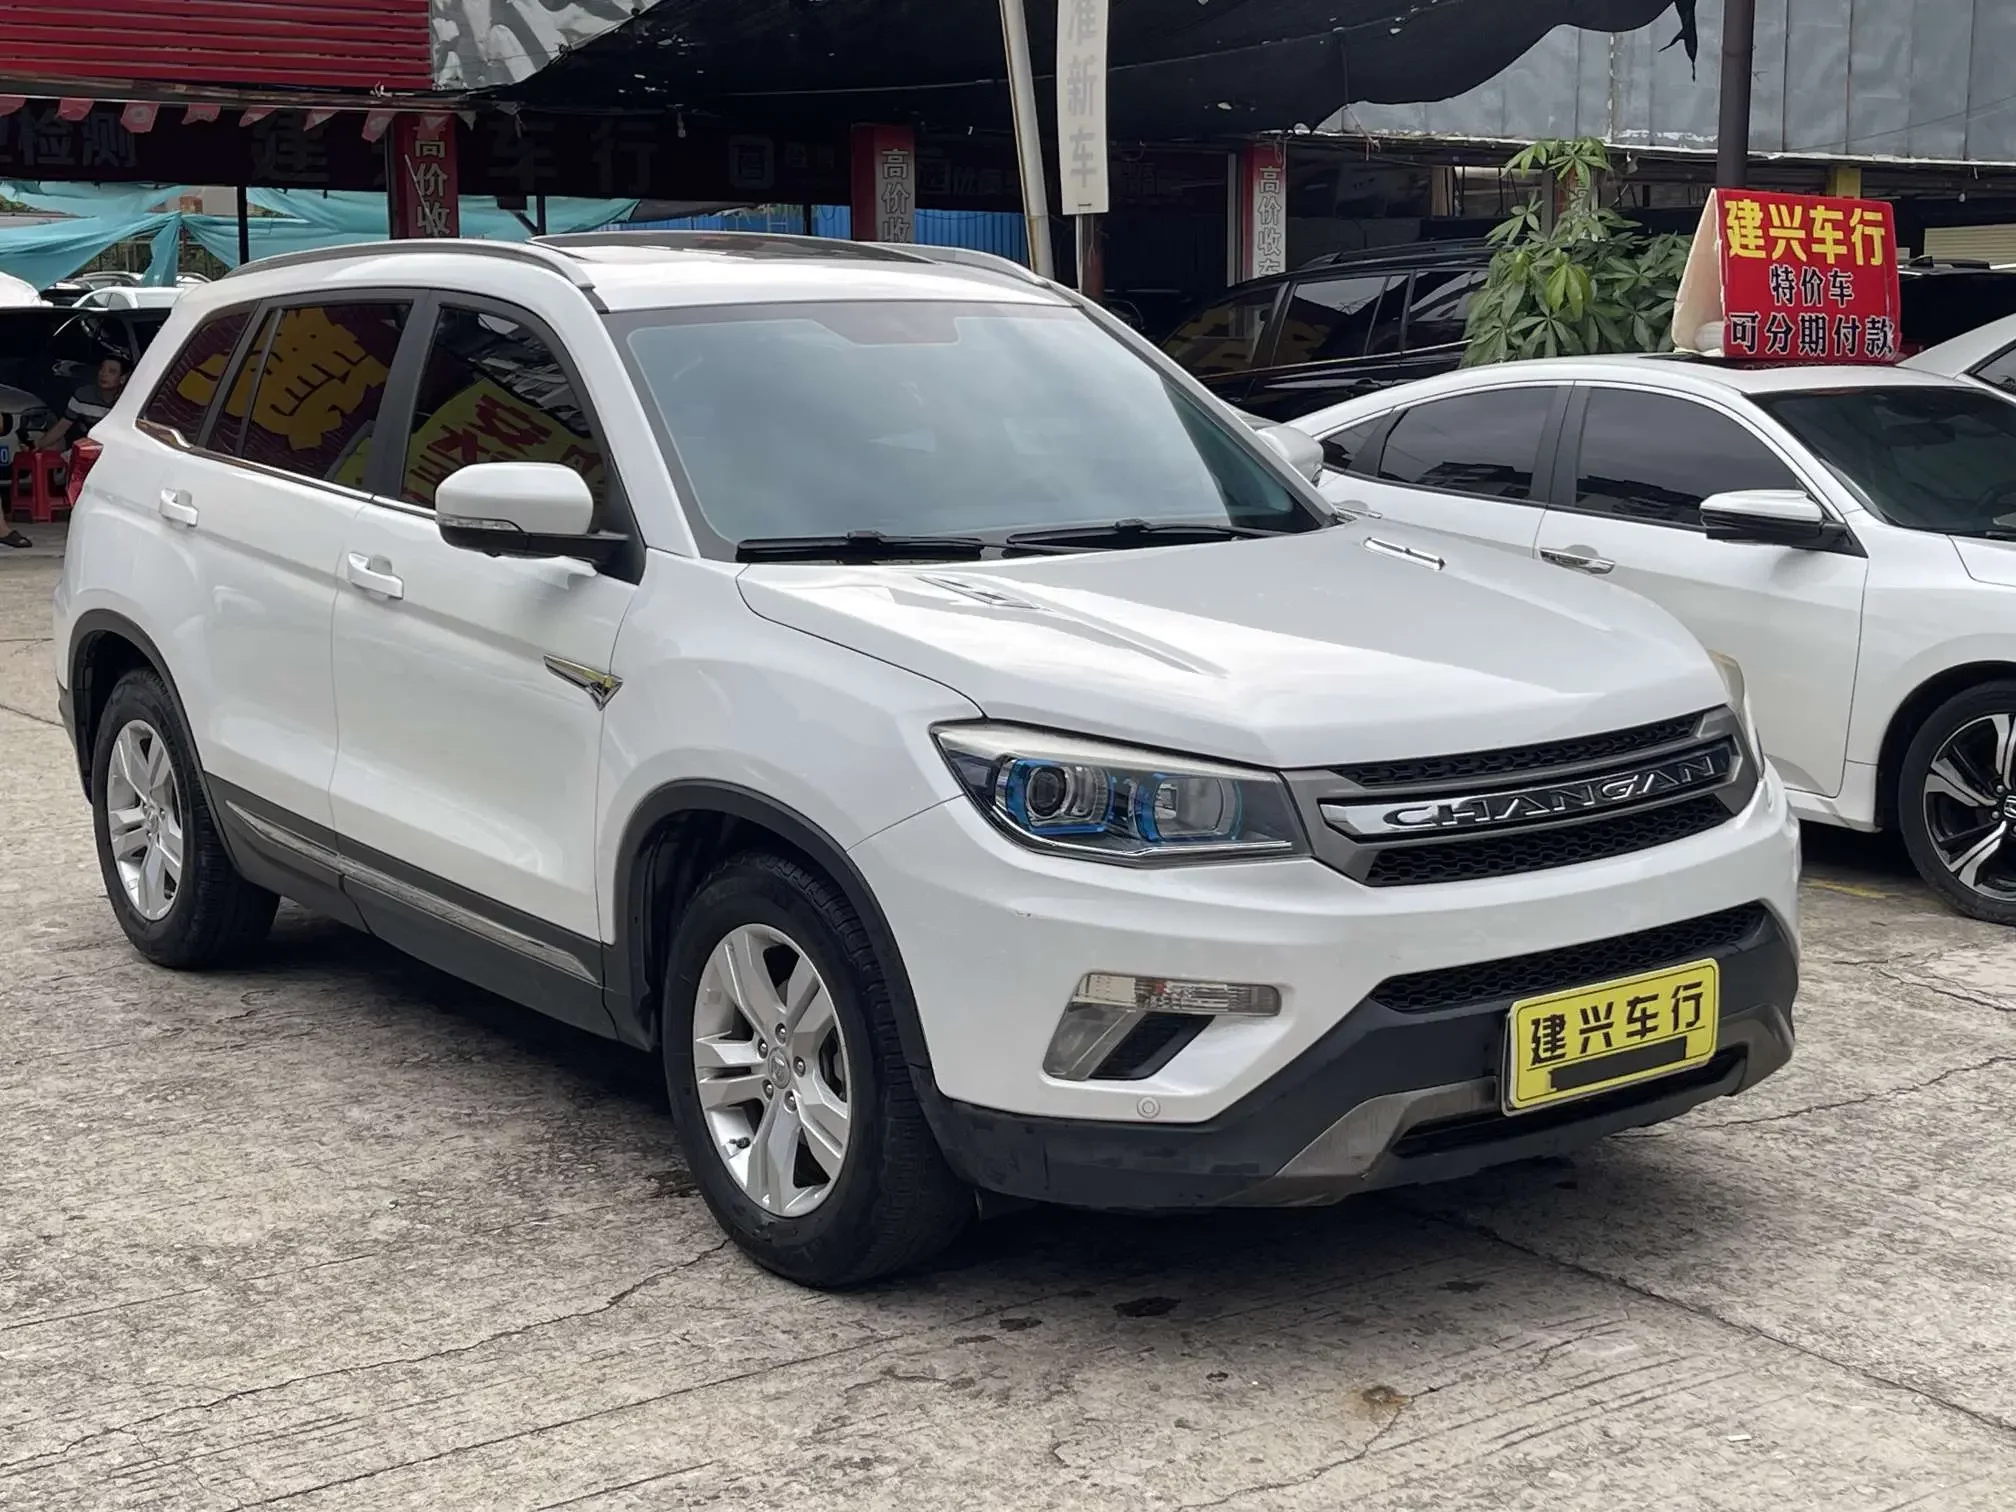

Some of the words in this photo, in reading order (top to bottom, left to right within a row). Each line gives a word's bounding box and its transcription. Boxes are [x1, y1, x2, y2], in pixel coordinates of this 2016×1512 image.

[881, 148, 911, 242] 高价收
[1723, 197, 1886, 267] 建兴车行
[1768, 263, 1855, 308] 特价车
[1728, 311, 1895, 357] 可分期付款
[1384, 755, 1715, 829] CHANGAN
[1530, 979, 1705, 1066] 建兴车行
